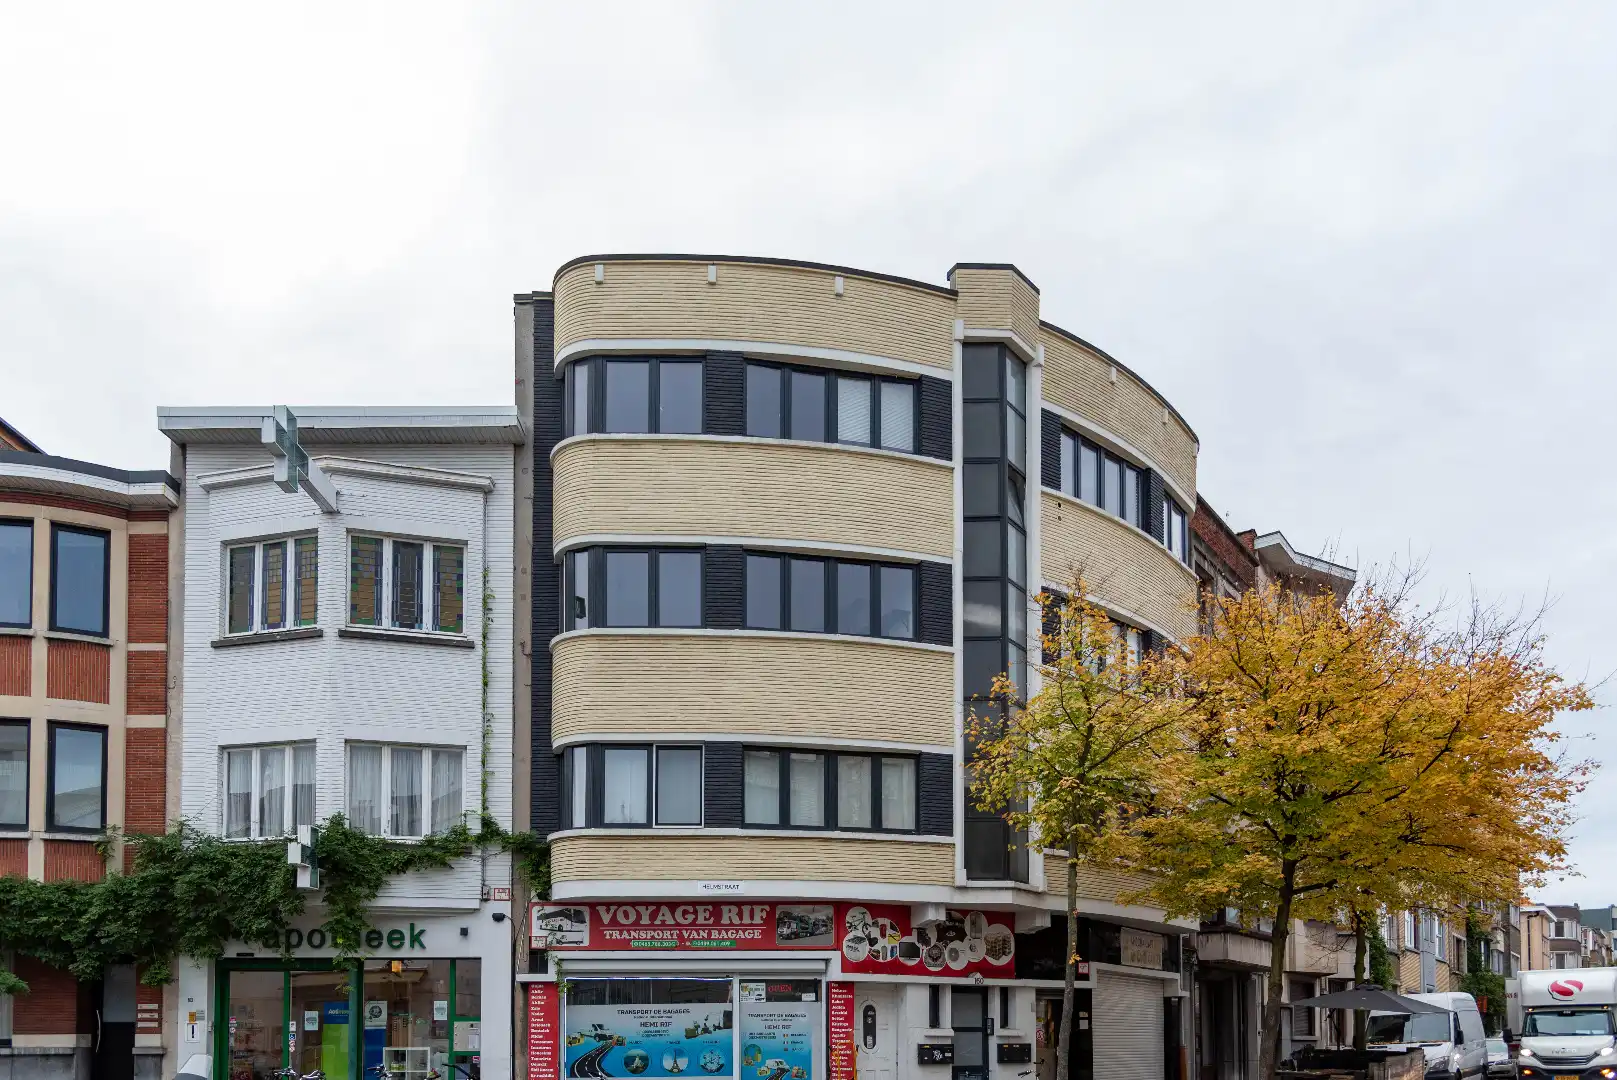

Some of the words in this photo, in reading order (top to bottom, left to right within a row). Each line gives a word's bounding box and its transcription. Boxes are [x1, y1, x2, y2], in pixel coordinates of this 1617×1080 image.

[596, 905, 714, 925] VOYAGE
[720, 905, 770, 925] RIF
[604, 930, 680, 940] TRANSPORT
[682, 930, 710, 939] VAN
[710, 929, 762, 939] BAGAGE
